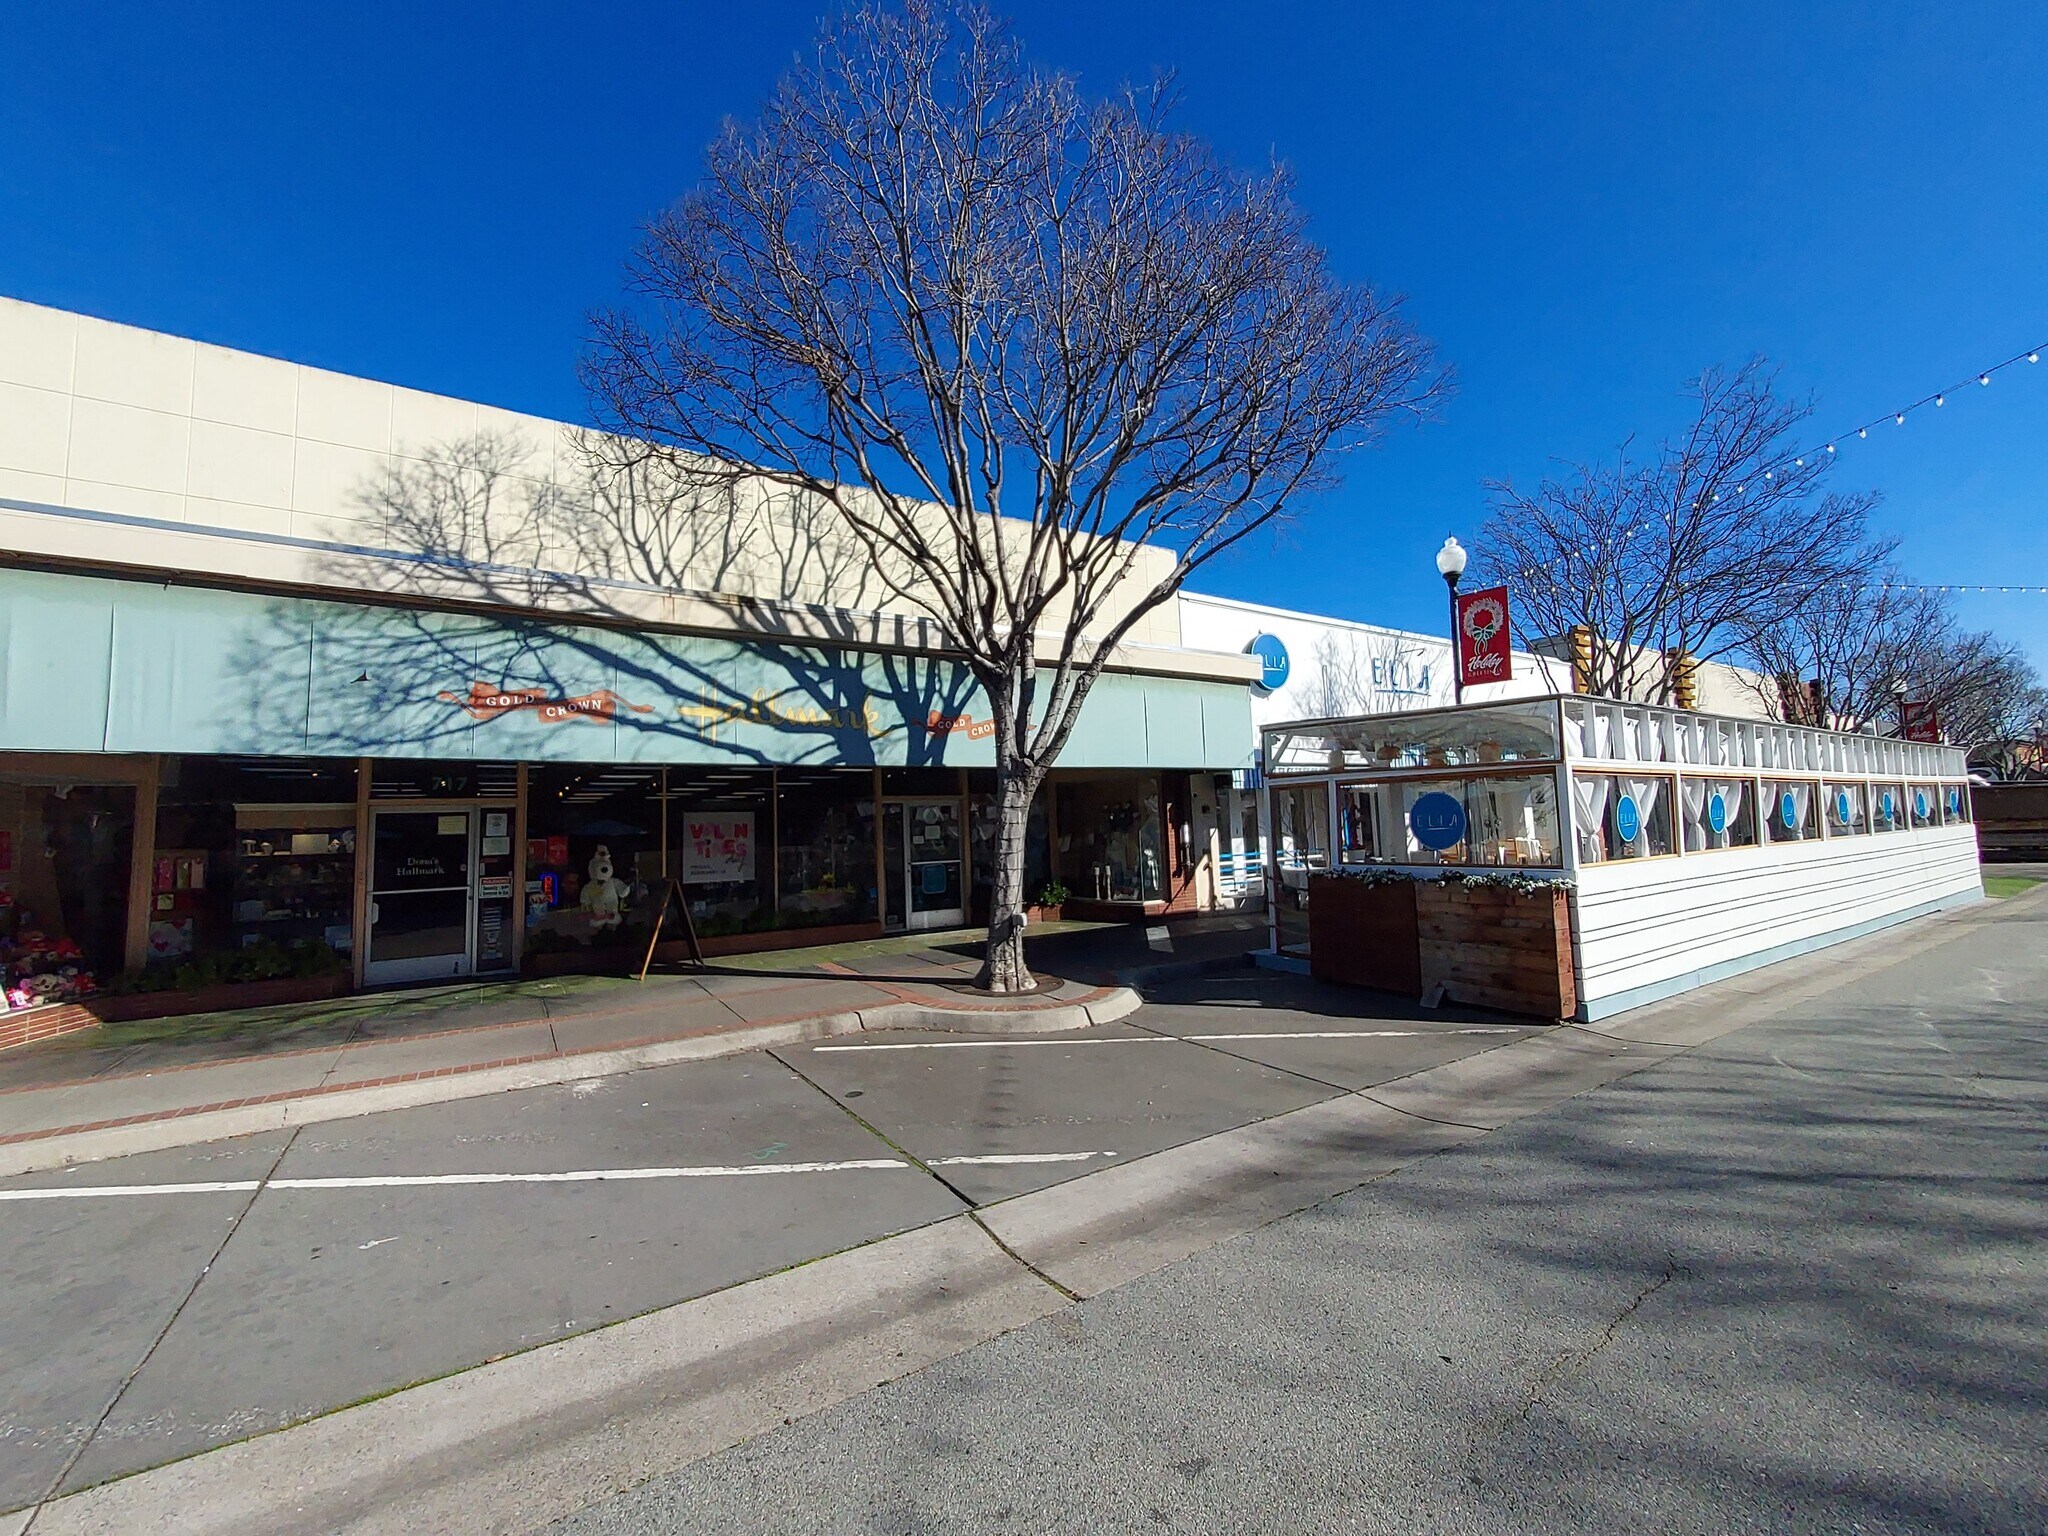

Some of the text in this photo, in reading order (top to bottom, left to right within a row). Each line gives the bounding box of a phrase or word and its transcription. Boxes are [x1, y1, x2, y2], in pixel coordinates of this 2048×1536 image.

[1264, 654, 1286, 669] LIA
[1467, 653, 1503, 675] Holiday
[1371, 657, 1430, 690] ELIA
[486, 694, 602, 716] GOLD CROWN
[674, 680, 887, 745] Hallmark
[937, 718, 996, 736] GOLD CRO
[1416, 814, 1458, 828] ELIA
[396, 866, 445, 876] Hallmark
